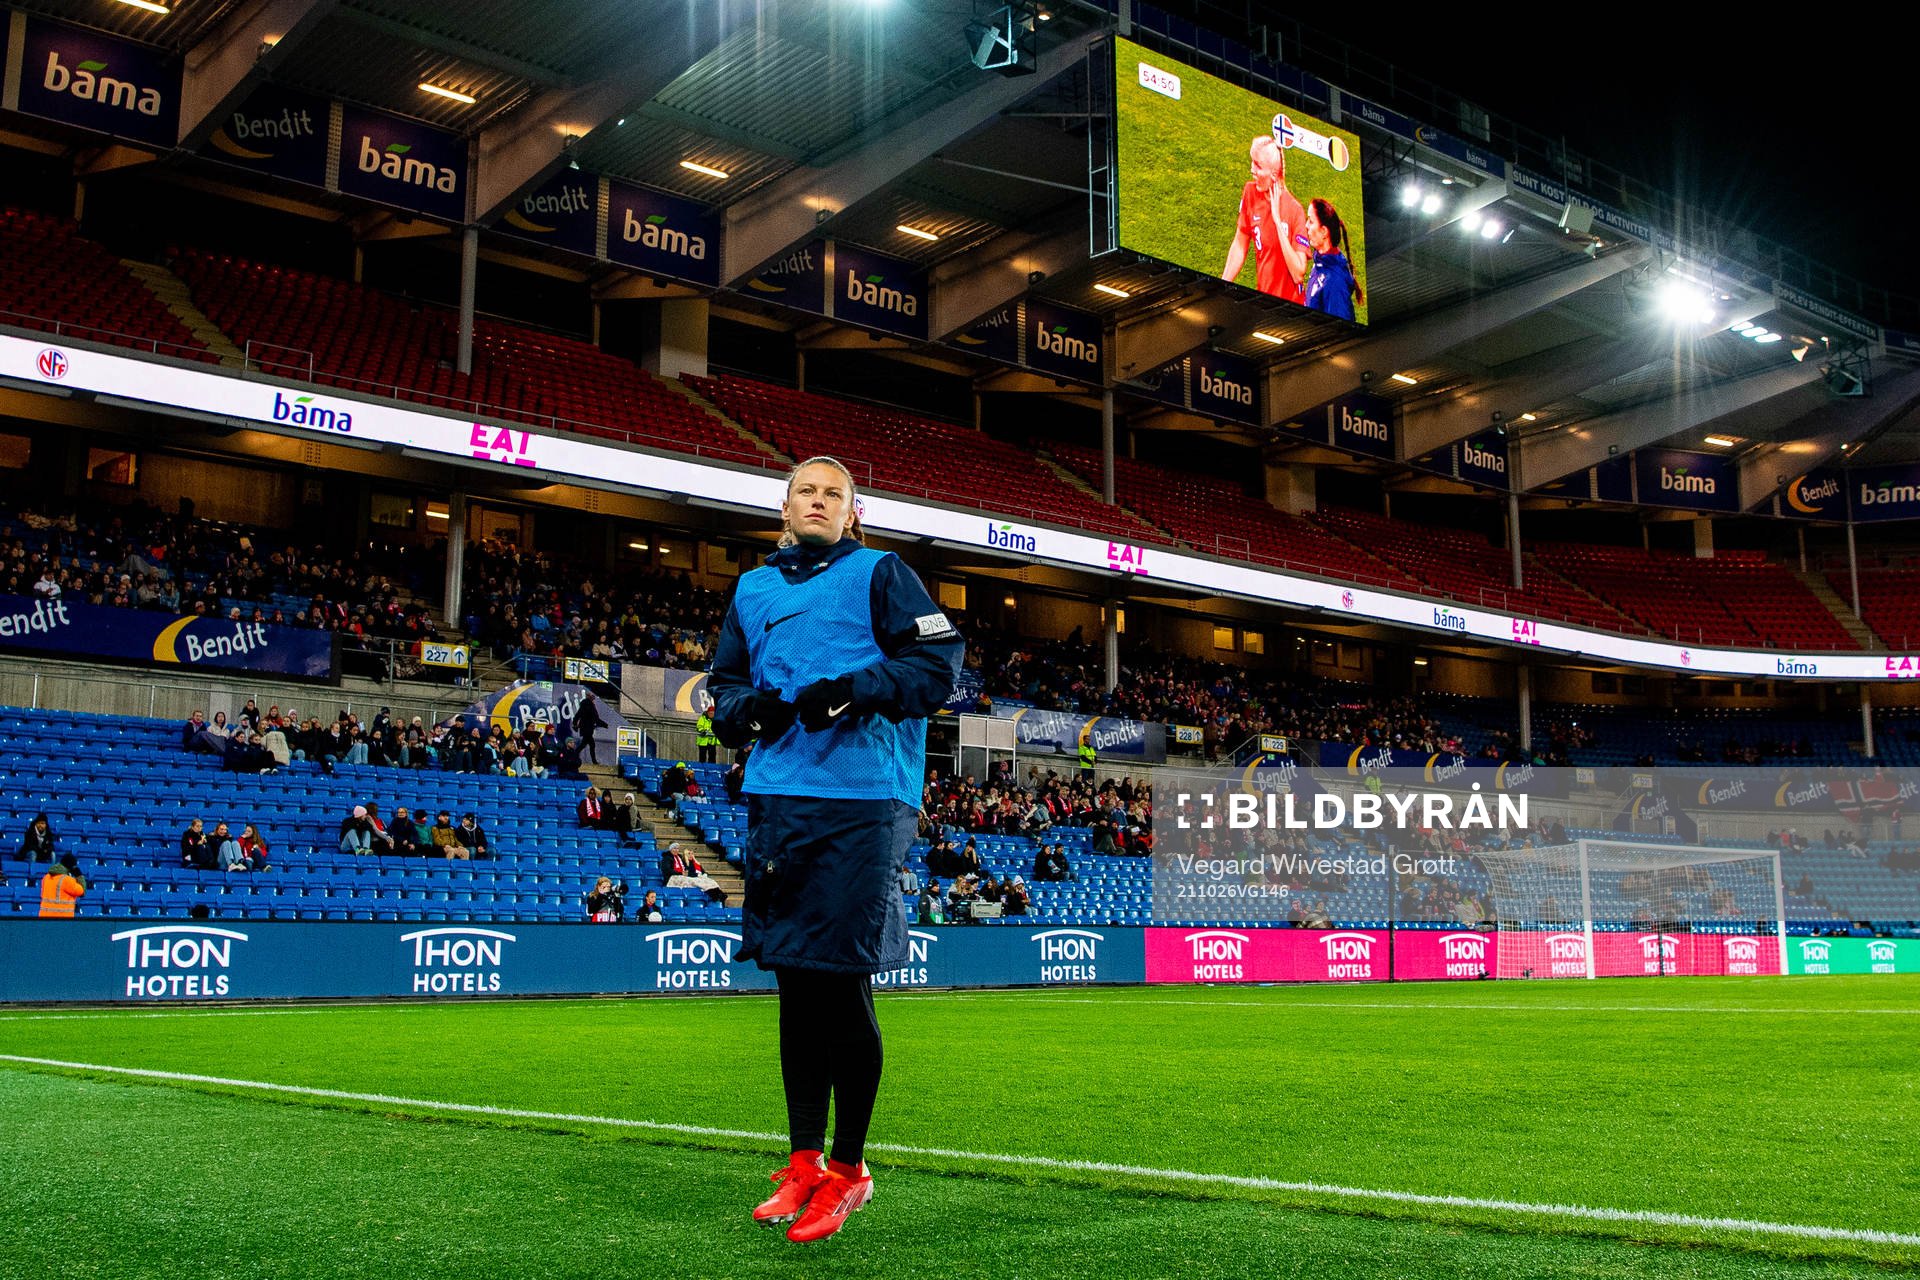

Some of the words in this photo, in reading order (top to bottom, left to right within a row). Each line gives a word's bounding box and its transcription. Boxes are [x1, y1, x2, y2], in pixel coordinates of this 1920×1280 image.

[1143, 70, 1175, 92] 54:50
[233, 108, 315, 140] Bendit
[1512, 169, 1539, 191] SUNT
[1605, 211, 1650, 239] AKTIVITET
[272, 392, 353, 433] bama
[1801, 478, 1840, 503] Bendit
[988, 523, 1036, 552] bama
[0, 599, 71, 638] endit
[921, 614, 946, 634] DNB
[186, 620, 269, 663] Bendit
[426, 649, 448, 663] 227
[1885, 656, 1920, 671] EA
[1022, 711, 1069, 743] Bendit
[1094, 718, 1138, 750] Bendit
[1178, 731, 1193, 741] 228
[1360, 747, 1394, 776] Bendit
[1435, 755, 1467, 783] Bendit
[1505, 762, 1535, 790] Bendit
[1709, 779, 1747, 804] Bendit
[1787, 781, 1828, 806] Bendit
[112, 925, 248, 968] THON
[401, 927, 516, 967] THON
[645, 928, 743, 964] THON
[1031, 929, 1104, 961] THON
[1185, 931, 1249, 961] THON
[1319, 932, 1377, 960] THON
[1438, 932, 1490, 959] THON
[1545, 934, 1587, 959] THON
[1723, 936, 1761, 960] THON
[1799, 939, 1832, 960] THON
[1866, 940, 1898, 960] THON
[657, 969, 732, 989] HOTELS
[1040, 964, 1097, 981] HOTELS
[1194, 964, 1243, 979] HOTELS
[1328, 964, 1372, 978] HOTELS
[1729, 963, 1758, 975] HOTELS
[1804, 963, 1830, 974] HOTELS
[1871, 963, 1896, 974] HOTELS
[126, 975, 230, 997] HOTELS
[413, 973, 501, 993] HOTELS
